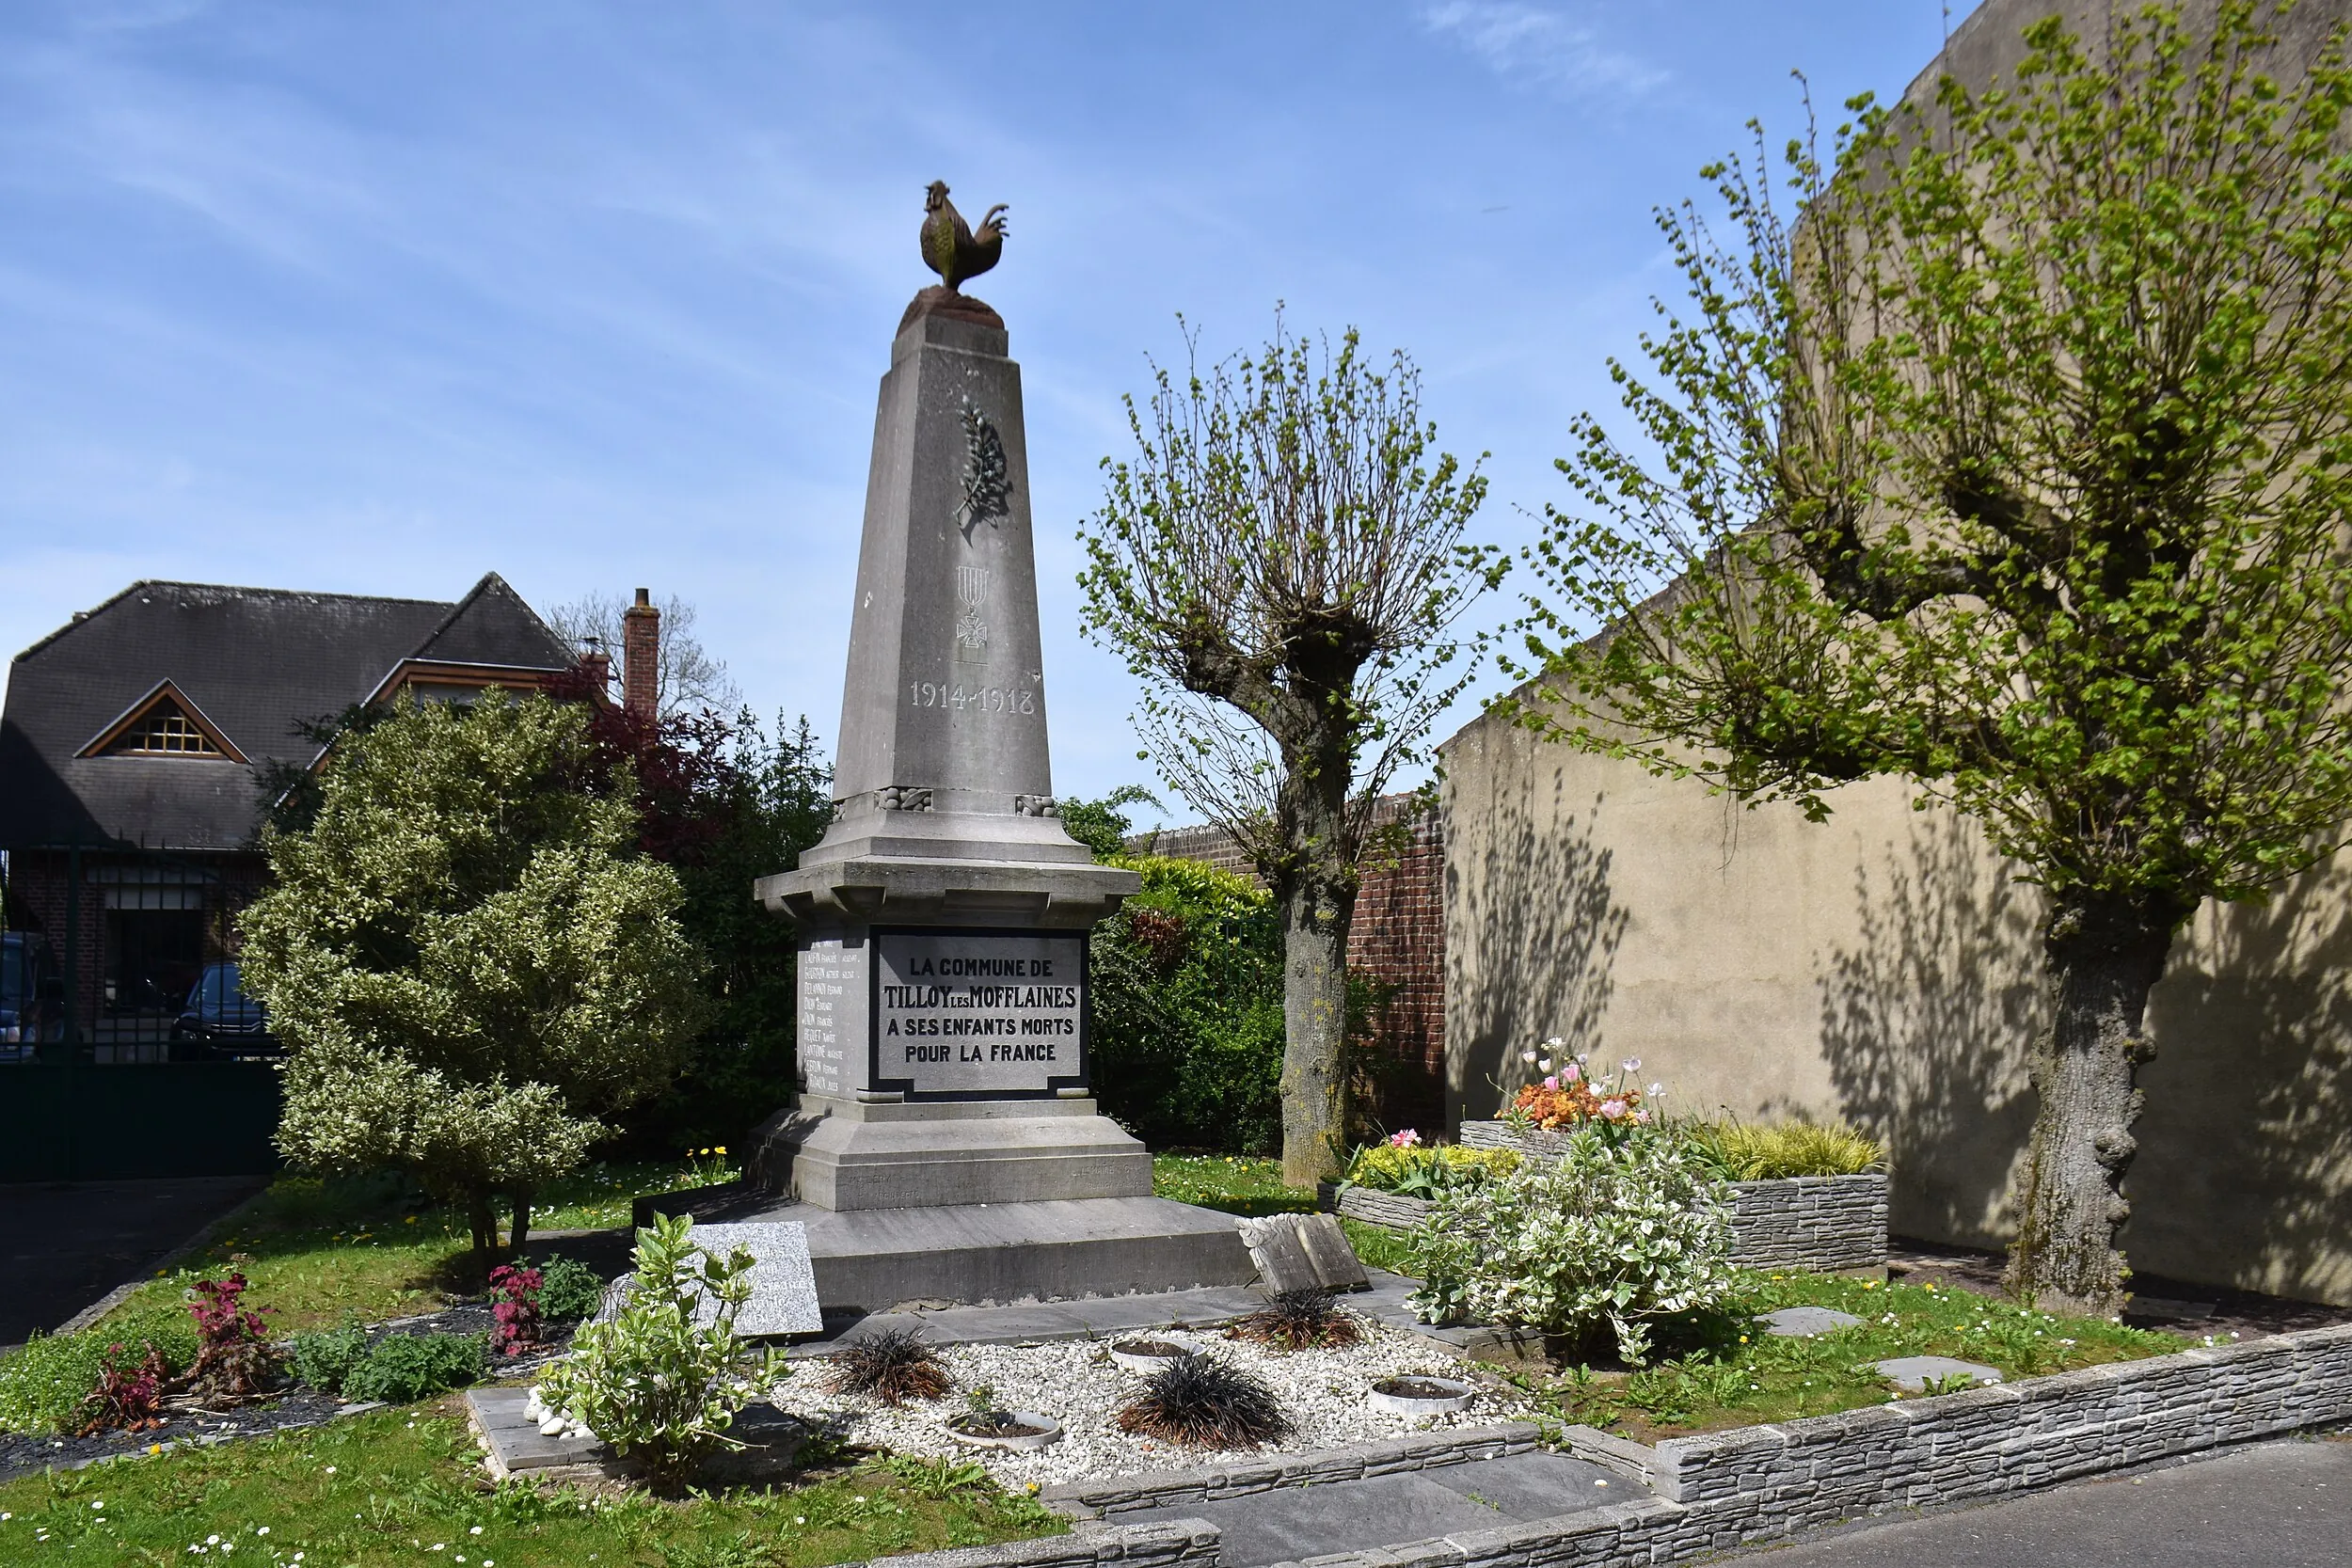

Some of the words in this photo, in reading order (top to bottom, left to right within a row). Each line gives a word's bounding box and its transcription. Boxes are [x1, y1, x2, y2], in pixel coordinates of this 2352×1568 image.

[910, 958, 935, 976] LA
[940, 958, 1025, 976] COMMUNE
[1030, 959, 1054, 976] DE
[884, 985, 951, 1009] TILLOY
[951, 996, 970, 1008] LES
[970, 986, 1076, 1009] MOFFLAINES
[887, 1018, 899, 1037] A
[904, 1018, 939, 1036] SES
[944, 1018, 1016, 1036] ENFANTS
[1021, 1018, 1074, 1036] MORTS
[905, 1045, 950, 1063] POUR
[960, 1045, 983, 1062] LA
[991, 1044, 1057, 1062] FRANCE
